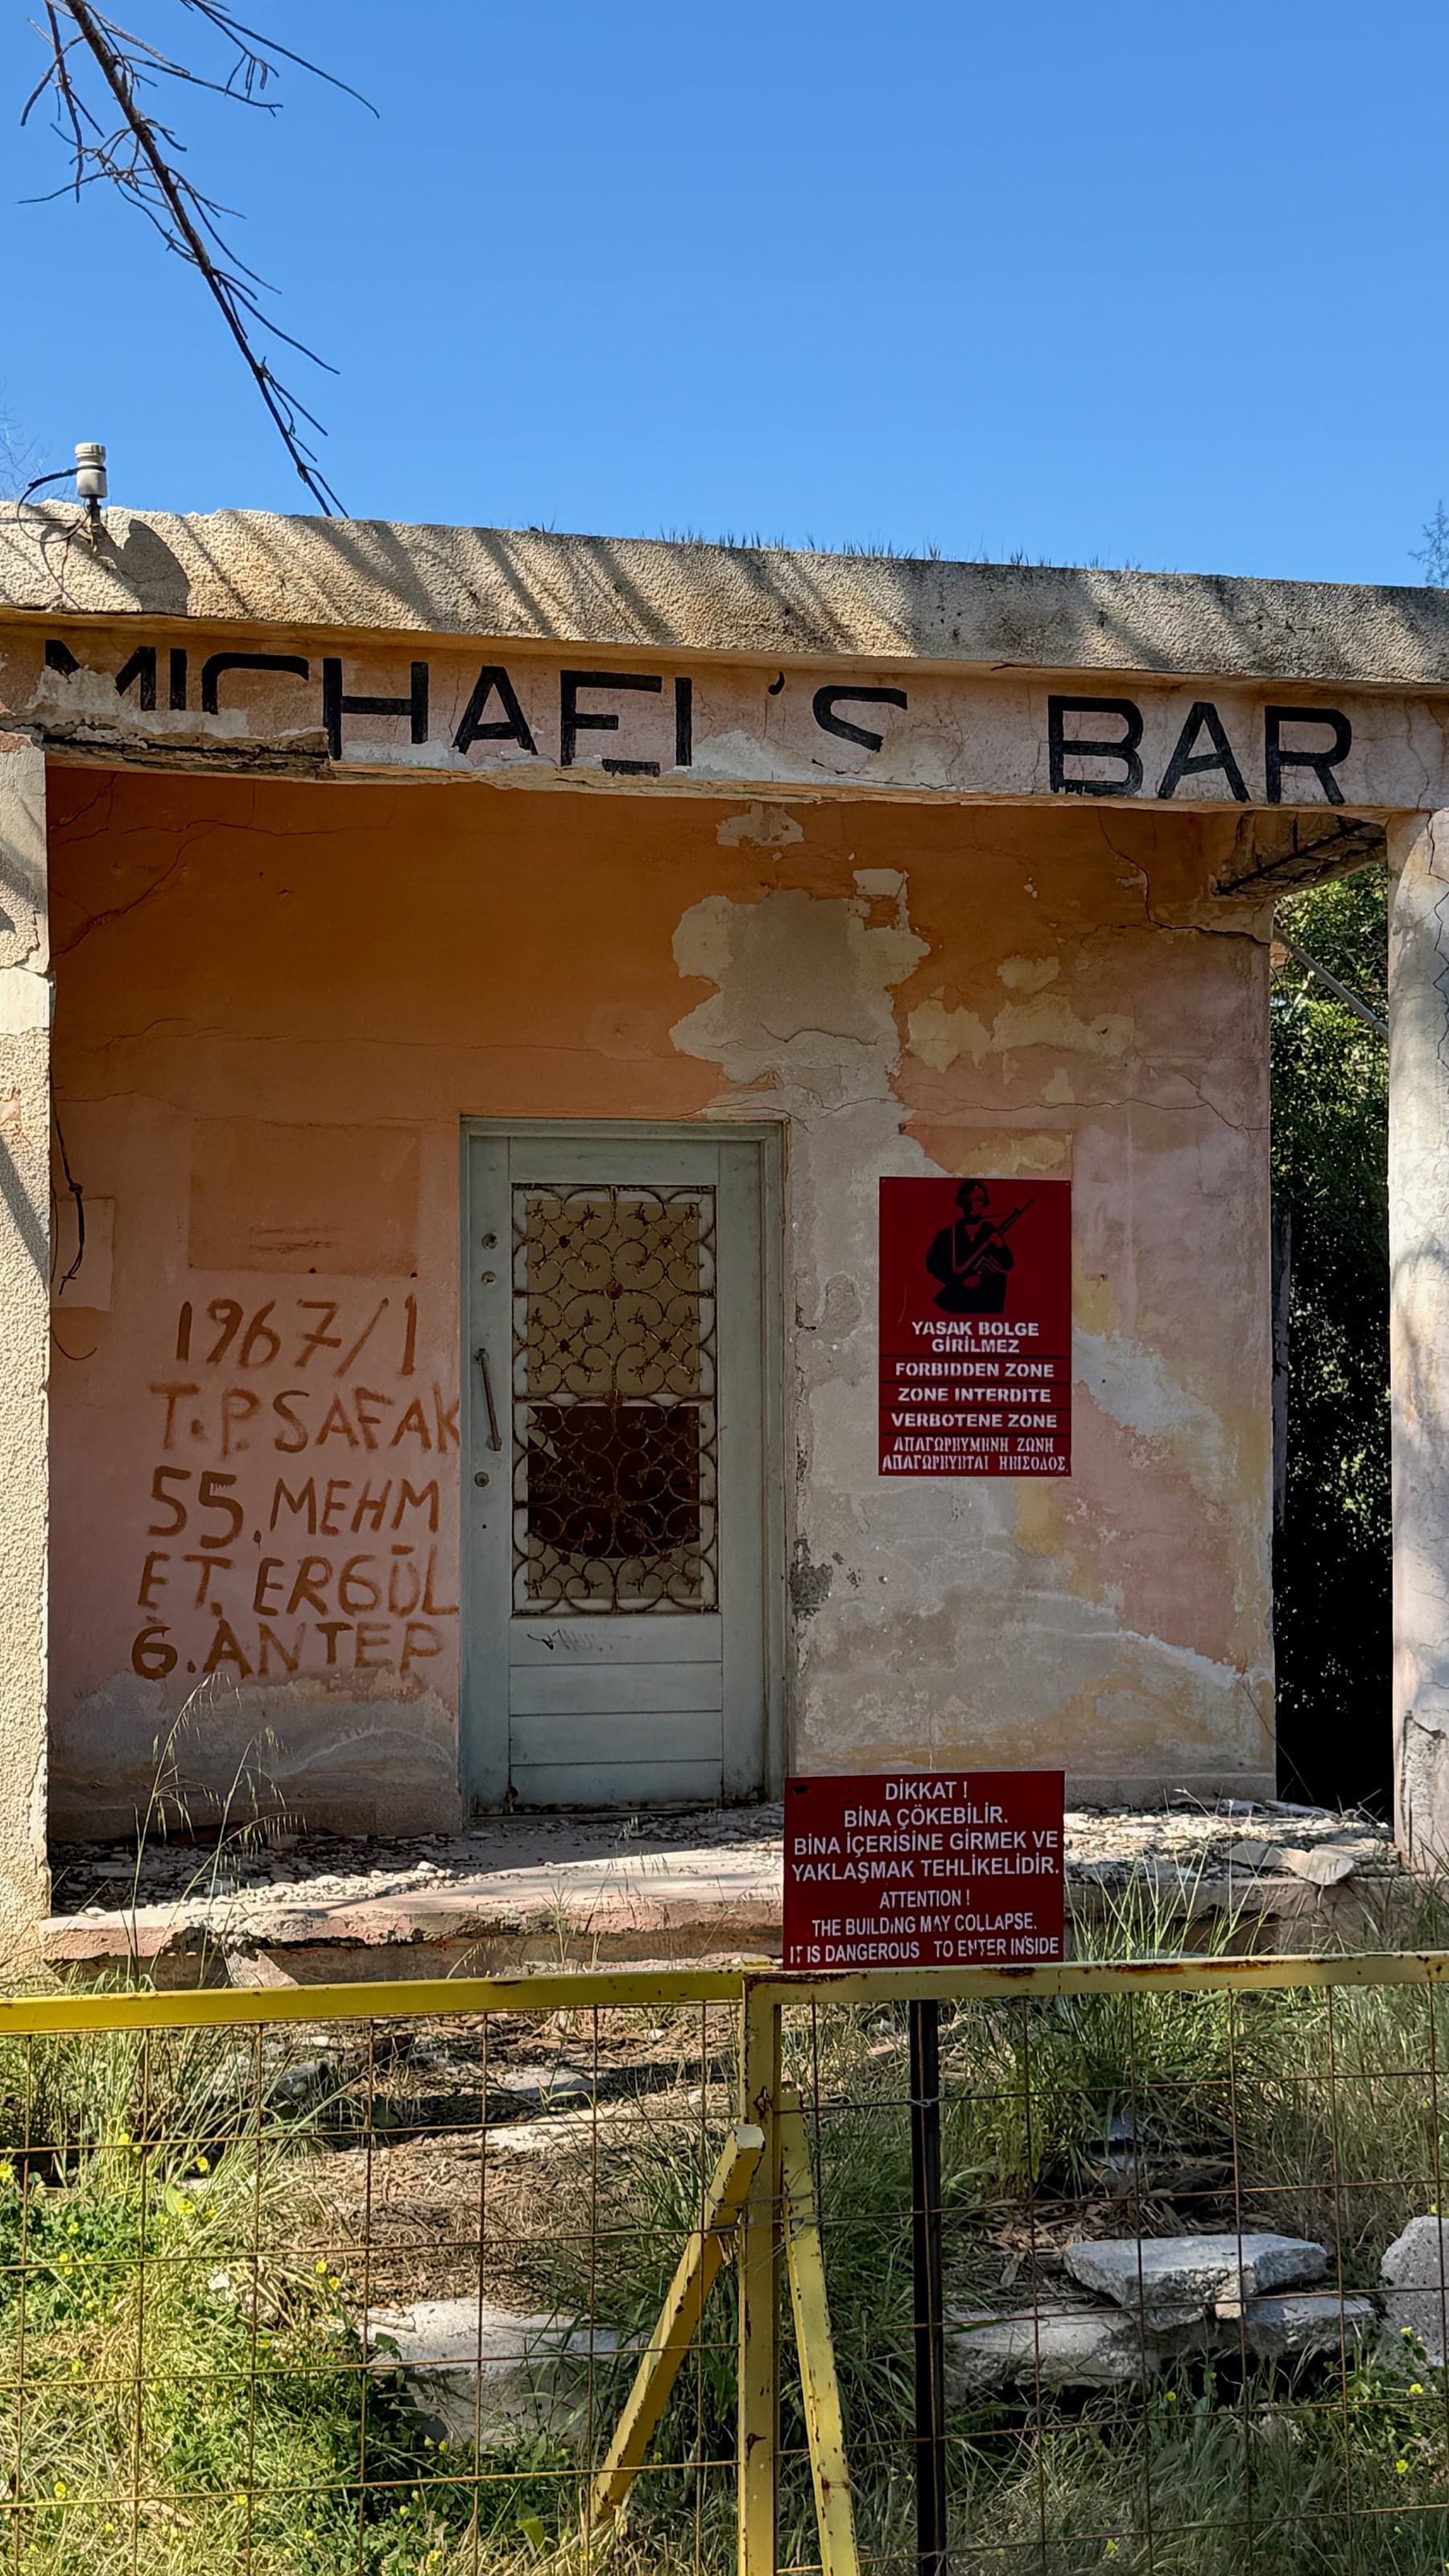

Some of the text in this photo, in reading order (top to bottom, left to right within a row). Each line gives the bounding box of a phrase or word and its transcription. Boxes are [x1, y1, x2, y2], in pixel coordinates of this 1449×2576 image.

[1047, 695, 1353, 806] BAR
[175, 1294, 417, 1377] 1967/1
[911, 1321, 973, 1335] YASAK
[931, 1335, 1020, 1353] GİRİLMEZ
[895, 1362, 1055, 1377] FORBIDDEN ZONE
[898, 1387, 1051, 1402] ZONE INTERDITE
[891, 1413, 1057, 1428] VERBOTENE ZONE
[886, 1778, 957, 1801] DİKKAT
[844, 1802, 1008, 1831] BİNA ÇÖKEBİLİR.
[794, 1828, 1059, 1857] BİNA İÇERİSİNE GİRMEK VE
[792, 1852, 1059, 1884] YAKLAŞMAK TEHLİKELİDİR.
[879, 1889, 961, 1909] ATTENTION
[811, 1912, 1037, 1938] THE BUILDING MAY COLLAPSE.
[807, 1945, 821, 1963] IS
[825, 1941, 920, 1962] DANGEROUS
[933, 1940, 954, 1959] TO
[958, 1938, 1006, 1957] ENTER
[1010, 1935, 1059, 1956] INSIDE
